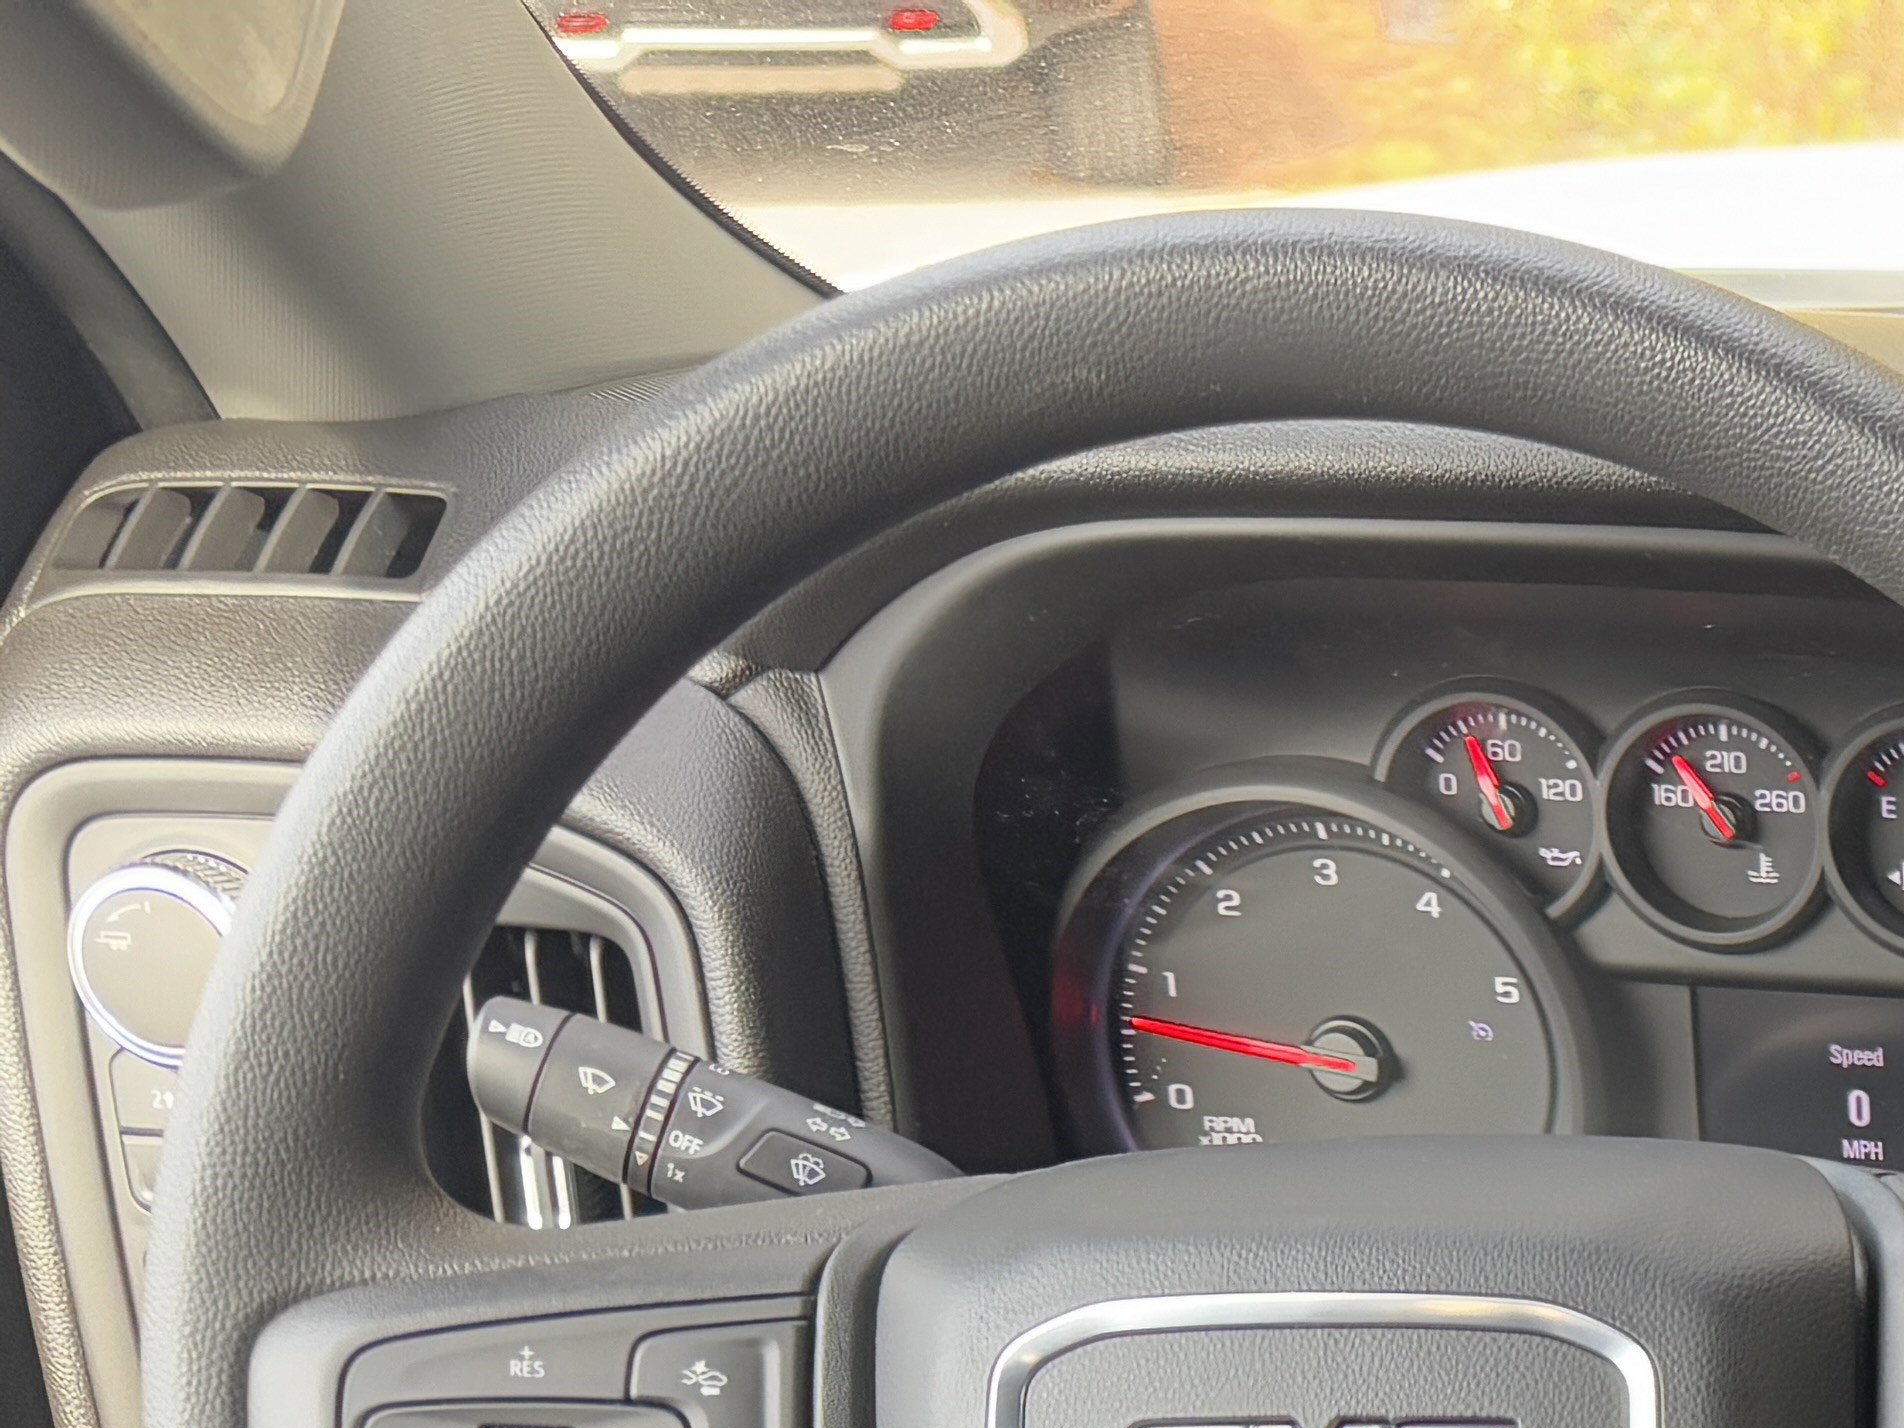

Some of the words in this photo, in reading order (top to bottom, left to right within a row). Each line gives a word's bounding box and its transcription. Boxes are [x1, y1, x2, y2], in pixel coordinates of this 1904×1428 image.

[1486, 739, 1522, 762] 60
[1705, 750, 1748, 774] 210
[1439, 773, 1458, 795] 0
[1538, 777, 1584, 802] 120
[1651, 783, 1695, 808] 160
[1754, 789, 1806, 814] 260
[1881, 796, 1898, 819] E
[1312, 858, 1339, 886] 3
[1215, 888, 1242, 917] 2
[1415, 891, 1442, 919] 4
[1161, 971, 1177, 998] 1
[1494, 976, 1520, 1004] 5
[1828, 1043, 1885, 1069] Speed
[1168, 1083, 1194, 1110] 0
[1847, 1089, 1871, 1128] 0
[1203, 1115, 1255, 1133] RPM
[668, 1130, 703, 1155] OFF
[1841, 1139, 1884, 1161] MPH
[666, 1162, 685, 1183] 1x
[509, 1360, 545, 1379] RES
